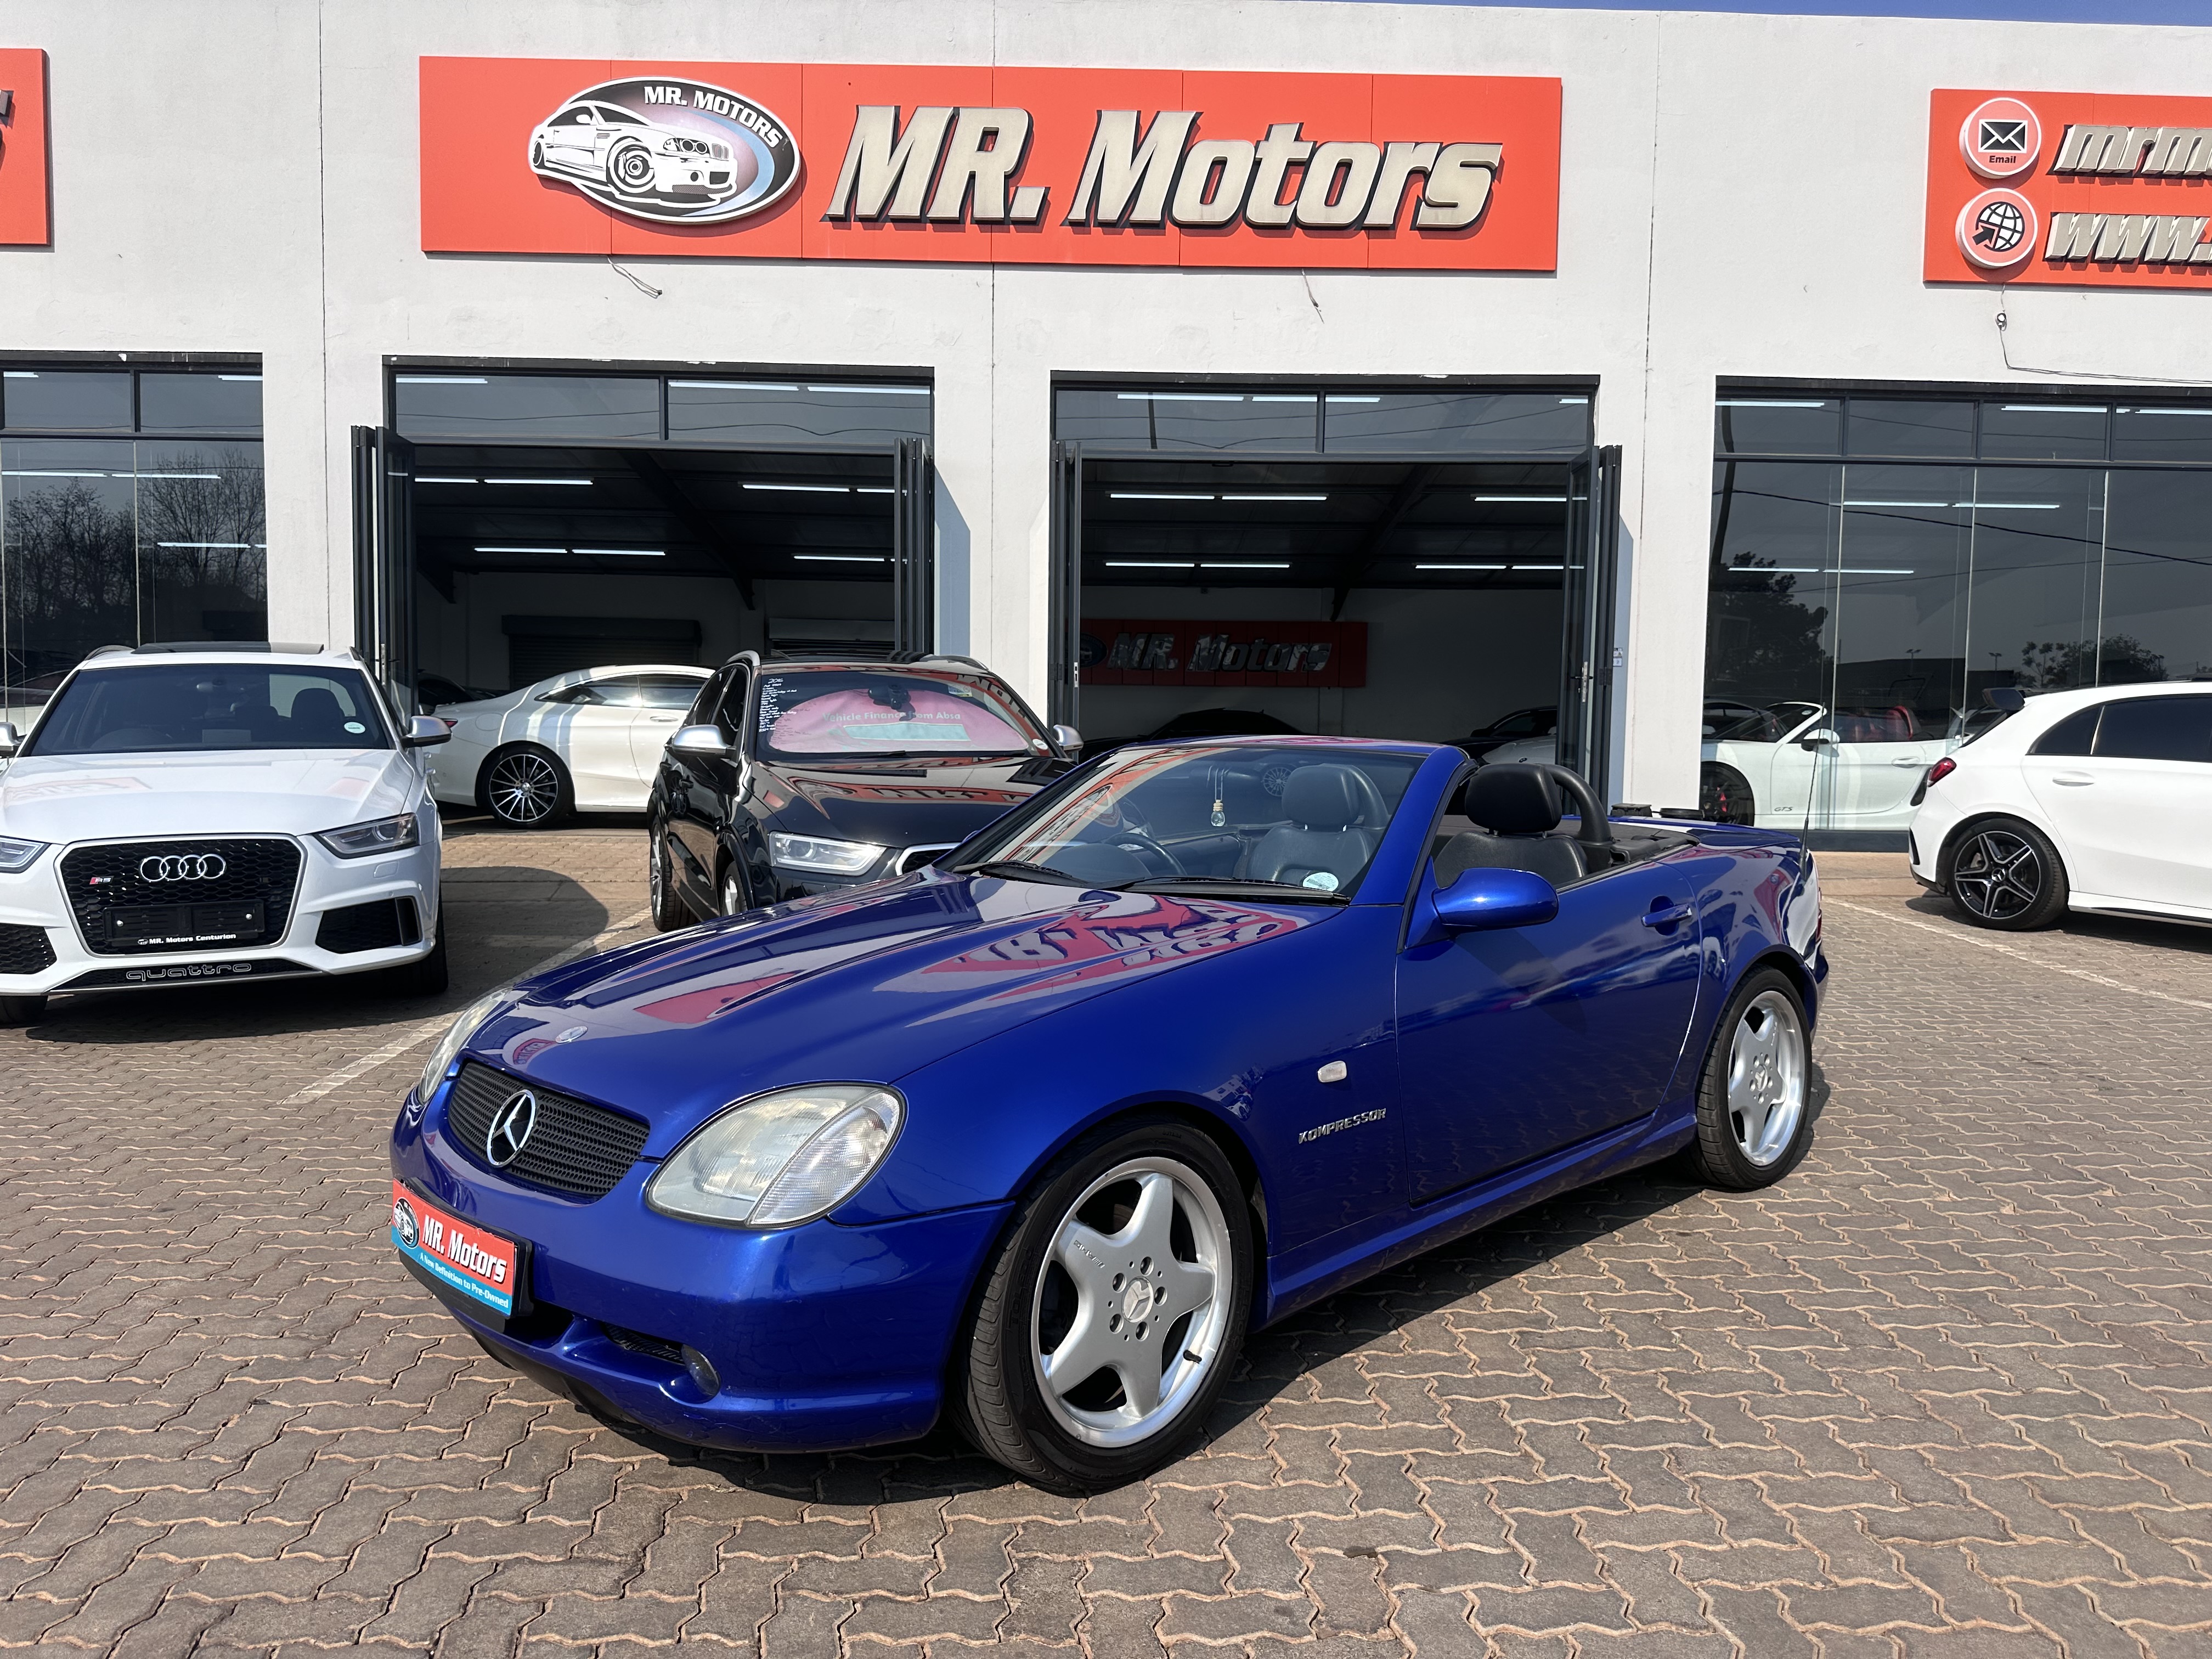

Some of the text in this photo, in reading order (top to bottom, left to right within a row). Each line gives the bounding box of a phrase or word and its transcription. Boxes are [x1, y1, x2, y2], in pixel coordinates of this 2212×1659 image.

[644, 86, 783, 148] MR. MOTORS
[825, 105, 1503, 228] MR. Motors
[1989, 155, 2016, 163] Email
[2052, 124, 2212, 176] mrm
[2044, 213, 2212, 262] www.
[1107, 632, 1179, 670] MR.
[1187, 633, 1332, 672] Motors
[822, 712, 861, 722] Vehicle
[864, 712, 906, 720] Finance
[936, 712, 961, 720] Absa
[126, 963, 252, 981] quattro
[1299, 1108, 1386, 1144] KOMPRESSOR
[422, 1214, 507, 1283] MR. Motors
[420, 1252, 509, 1308] A New Definition to Pre-Owned
